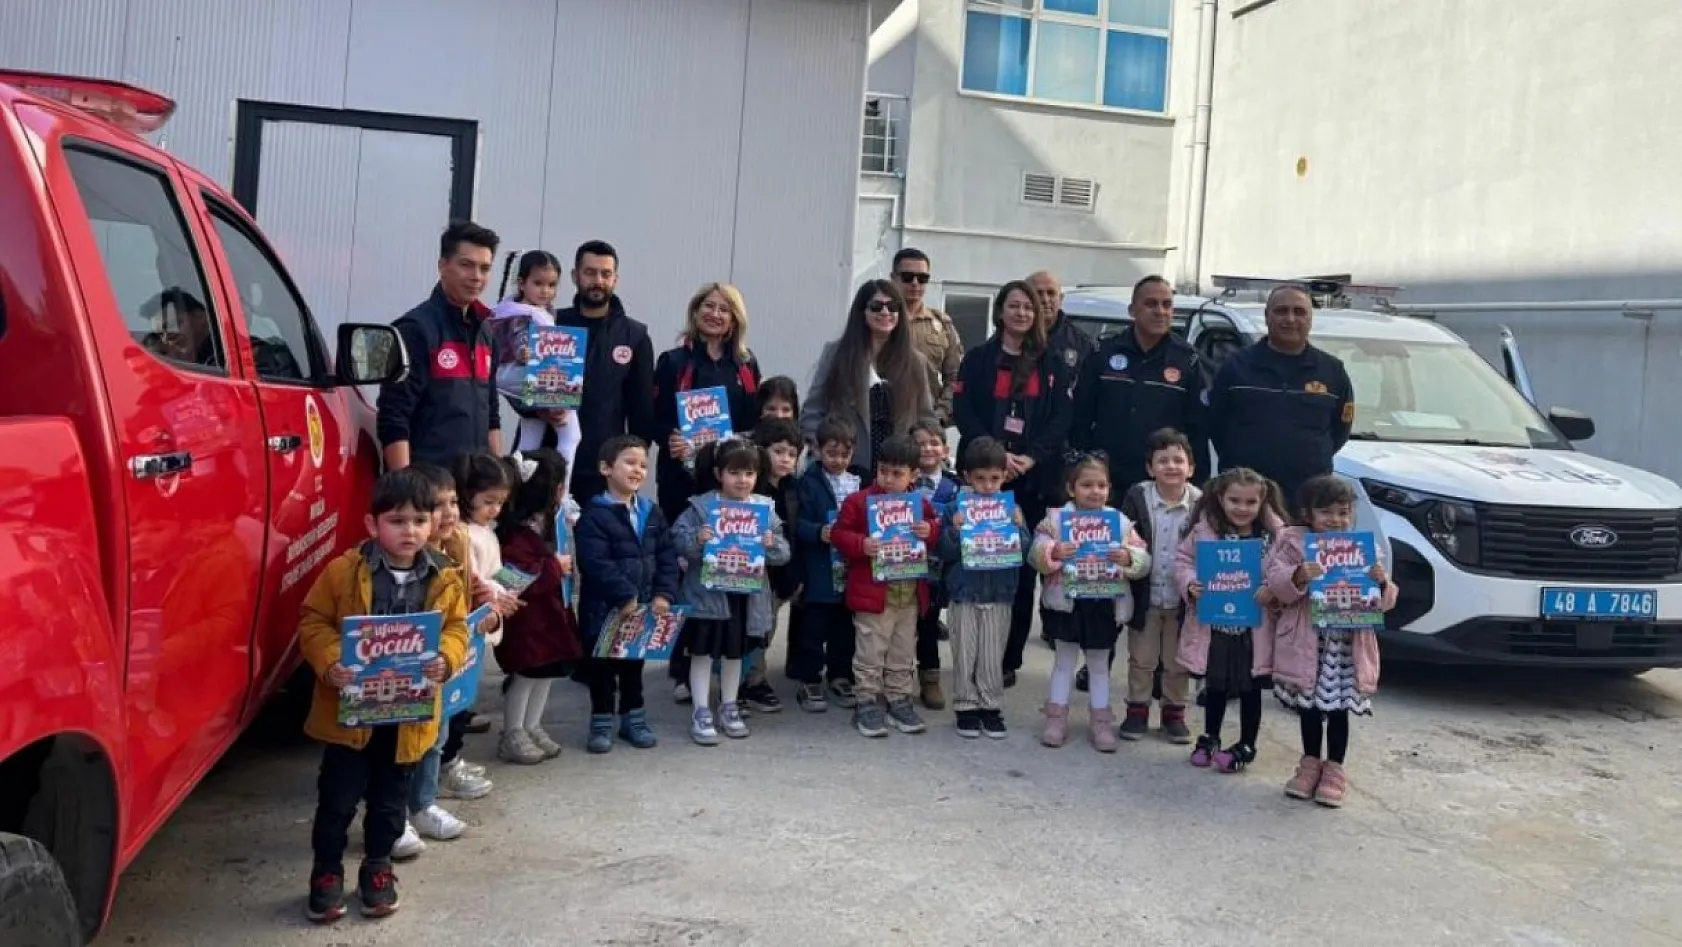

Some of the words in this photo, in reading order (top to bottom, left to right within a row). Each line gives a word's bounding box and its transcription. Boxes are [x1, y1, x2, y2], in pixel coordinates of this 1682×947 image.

[1216, 548, 1241, 563] 112
[1315, 547, 1366, 574] Çocuk
[1555, 592, 1576, 613] 48
[1587, 592, 1597, 613] A
[1609, 593, 1653, 615] 7846
[355, 633, 425, 665] Çocuk
